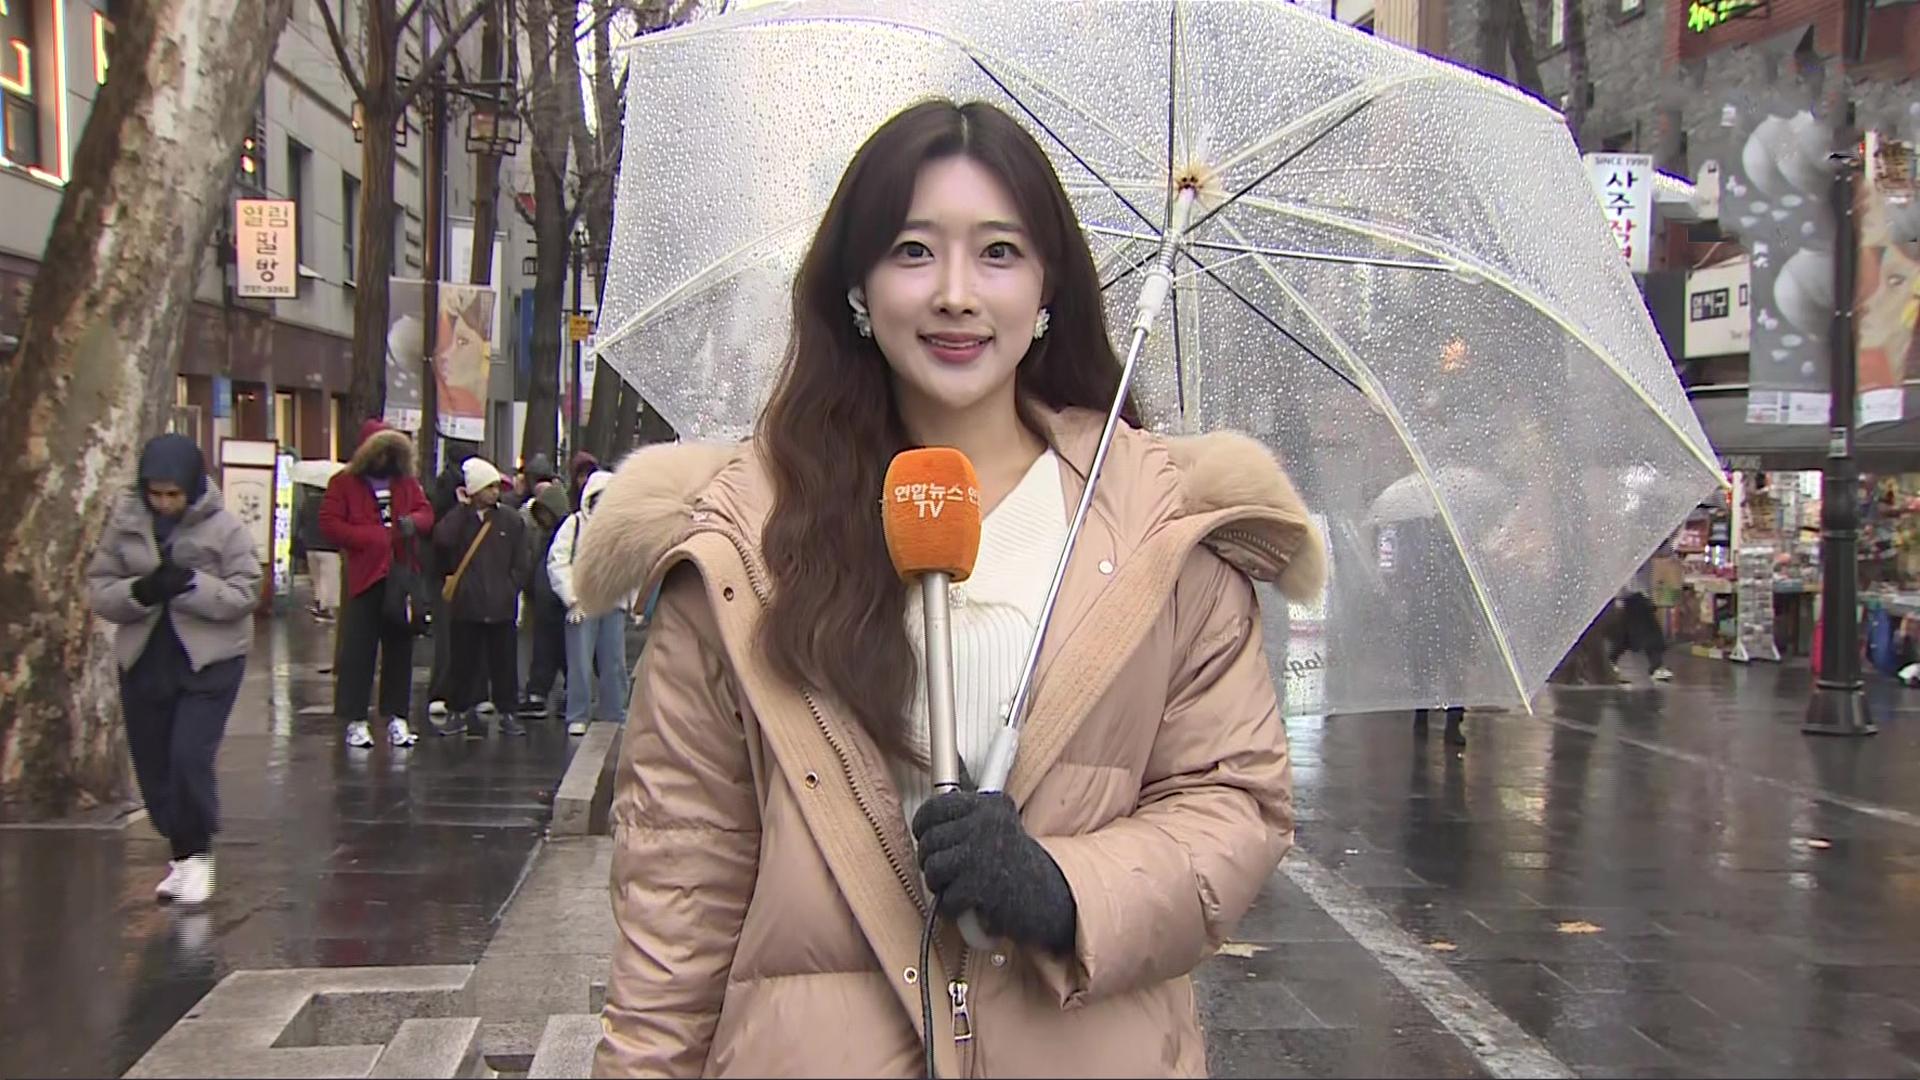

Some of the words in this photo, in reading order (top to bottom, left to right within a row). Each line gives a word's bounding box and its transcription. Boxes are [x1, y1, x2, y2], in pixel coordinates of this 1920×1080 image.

[243, 205, 289, 228] 열림
[894, 483, 963, 502] 연합뉴스
[914, 500, 945, 518] TV
